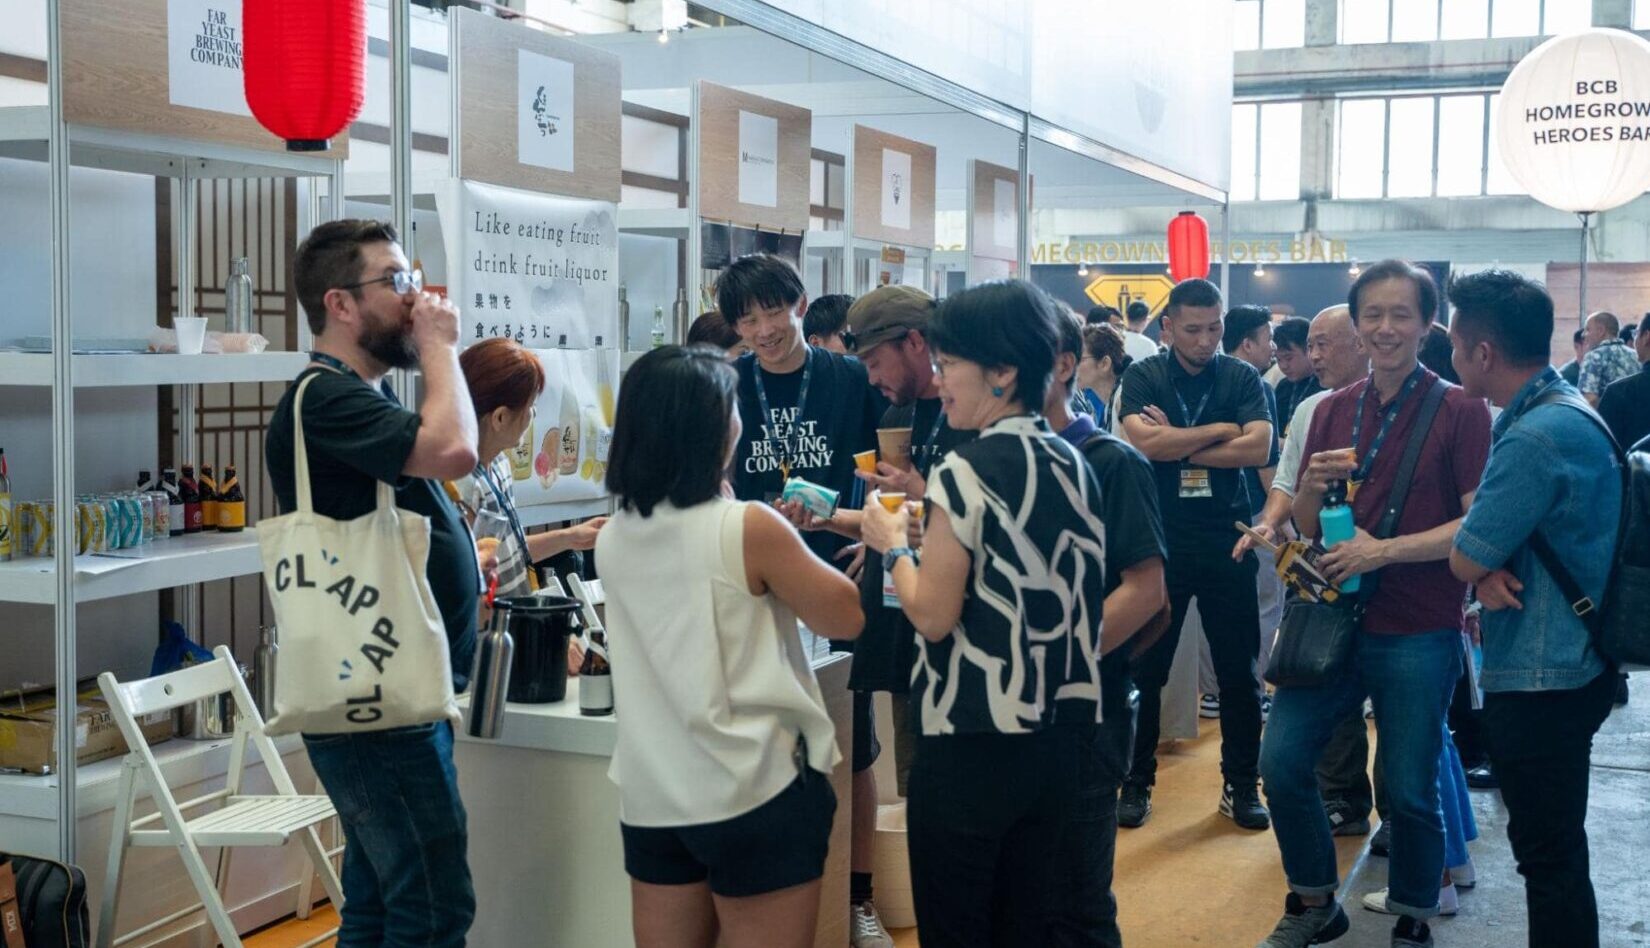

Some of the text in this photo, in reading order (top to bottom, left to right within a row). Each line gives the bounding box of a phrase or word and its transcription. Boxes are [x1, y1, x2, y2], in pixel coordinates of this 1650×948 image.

[208, 9, 226, 25] FAR
[202, 21, 235, 41] YEAST
[196, 34, 242, 56] BREWING
[1576, 80, 1618, 95] BCB
[1526, 102, 1650, 123] HOMEGROW
[1534, 126, 1614, 145] HEROES
[474, 211, 601, 248] Like eating fruit
[1030, 238, 1348, 263] MEGROWN ROES BAR
[474, 250, 608, 285] drink fruit liquor
[475, 293, 511, 310] 果物を
[475, 322, 551, 340] 食べるように
